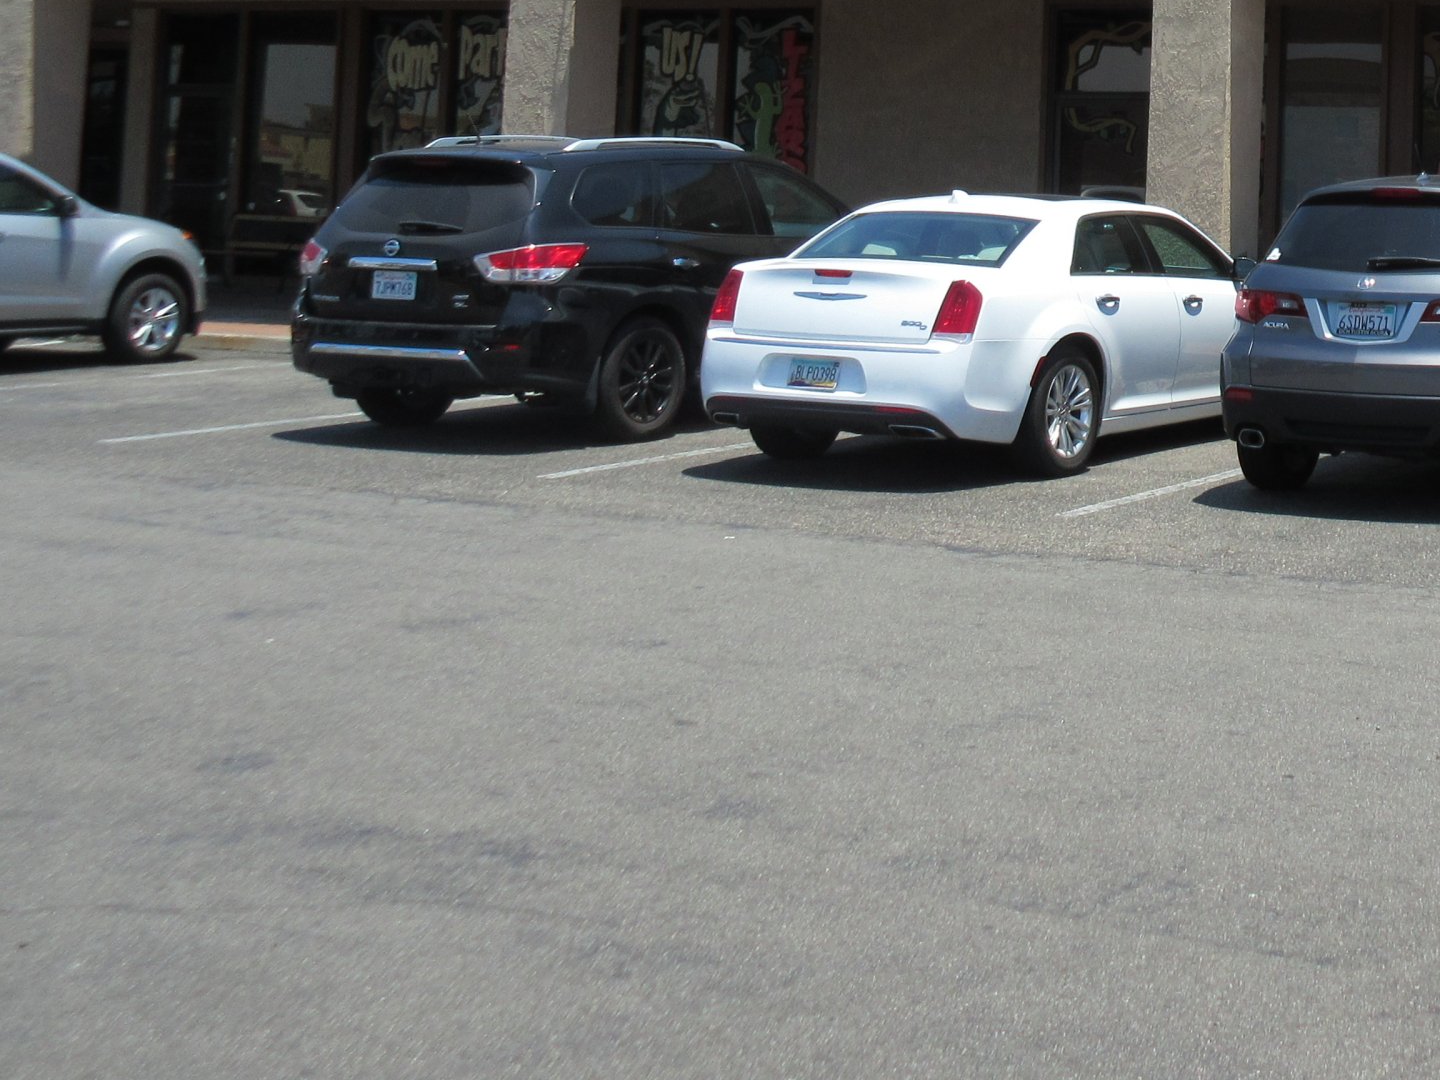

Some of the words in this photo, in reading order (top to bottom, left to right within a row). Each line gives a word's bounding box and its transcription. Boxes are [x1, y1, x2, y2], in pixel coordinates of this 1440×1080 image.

[460, 24, 508, 81] Part
[1263, 321, 1290, 330] ACURA
[1338, 314, 1389, 331] 6SDW571
